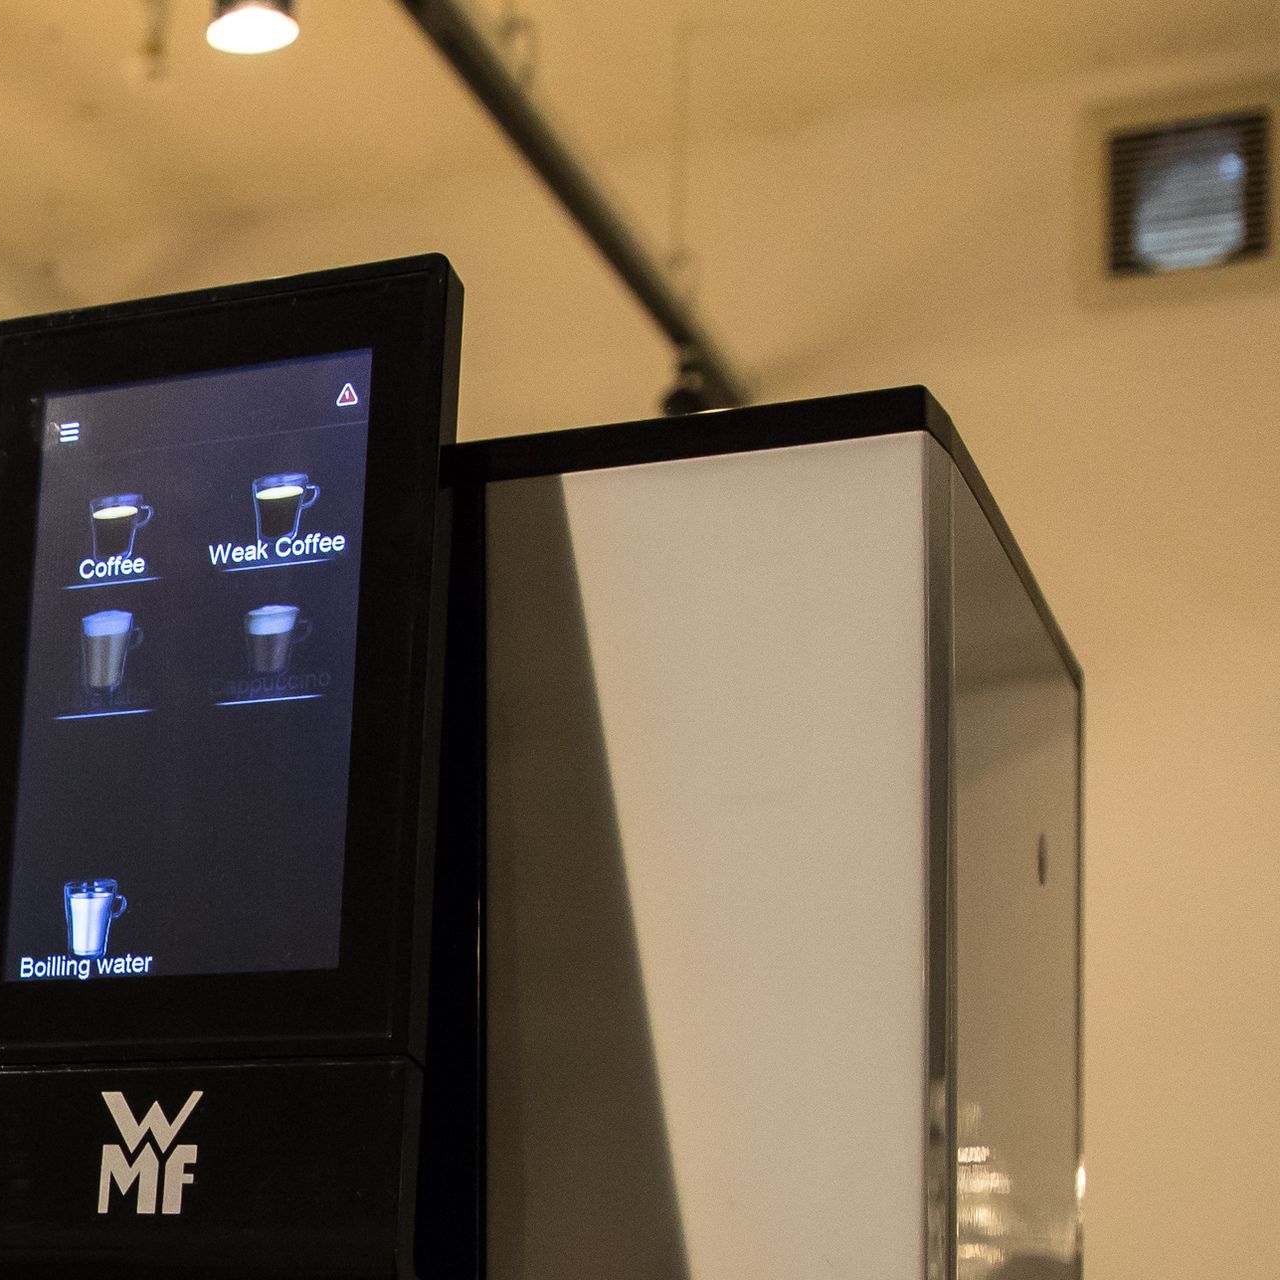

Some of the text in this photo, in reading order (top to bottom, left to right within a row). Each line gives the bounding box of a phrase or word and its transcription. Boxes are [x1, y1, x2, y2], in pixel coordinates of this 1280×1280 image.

[209, 533, 345, 565] Weak Coffee
[79, 556, 145, 580] Coffee
[20, 953, 153, 981] Boilling water
